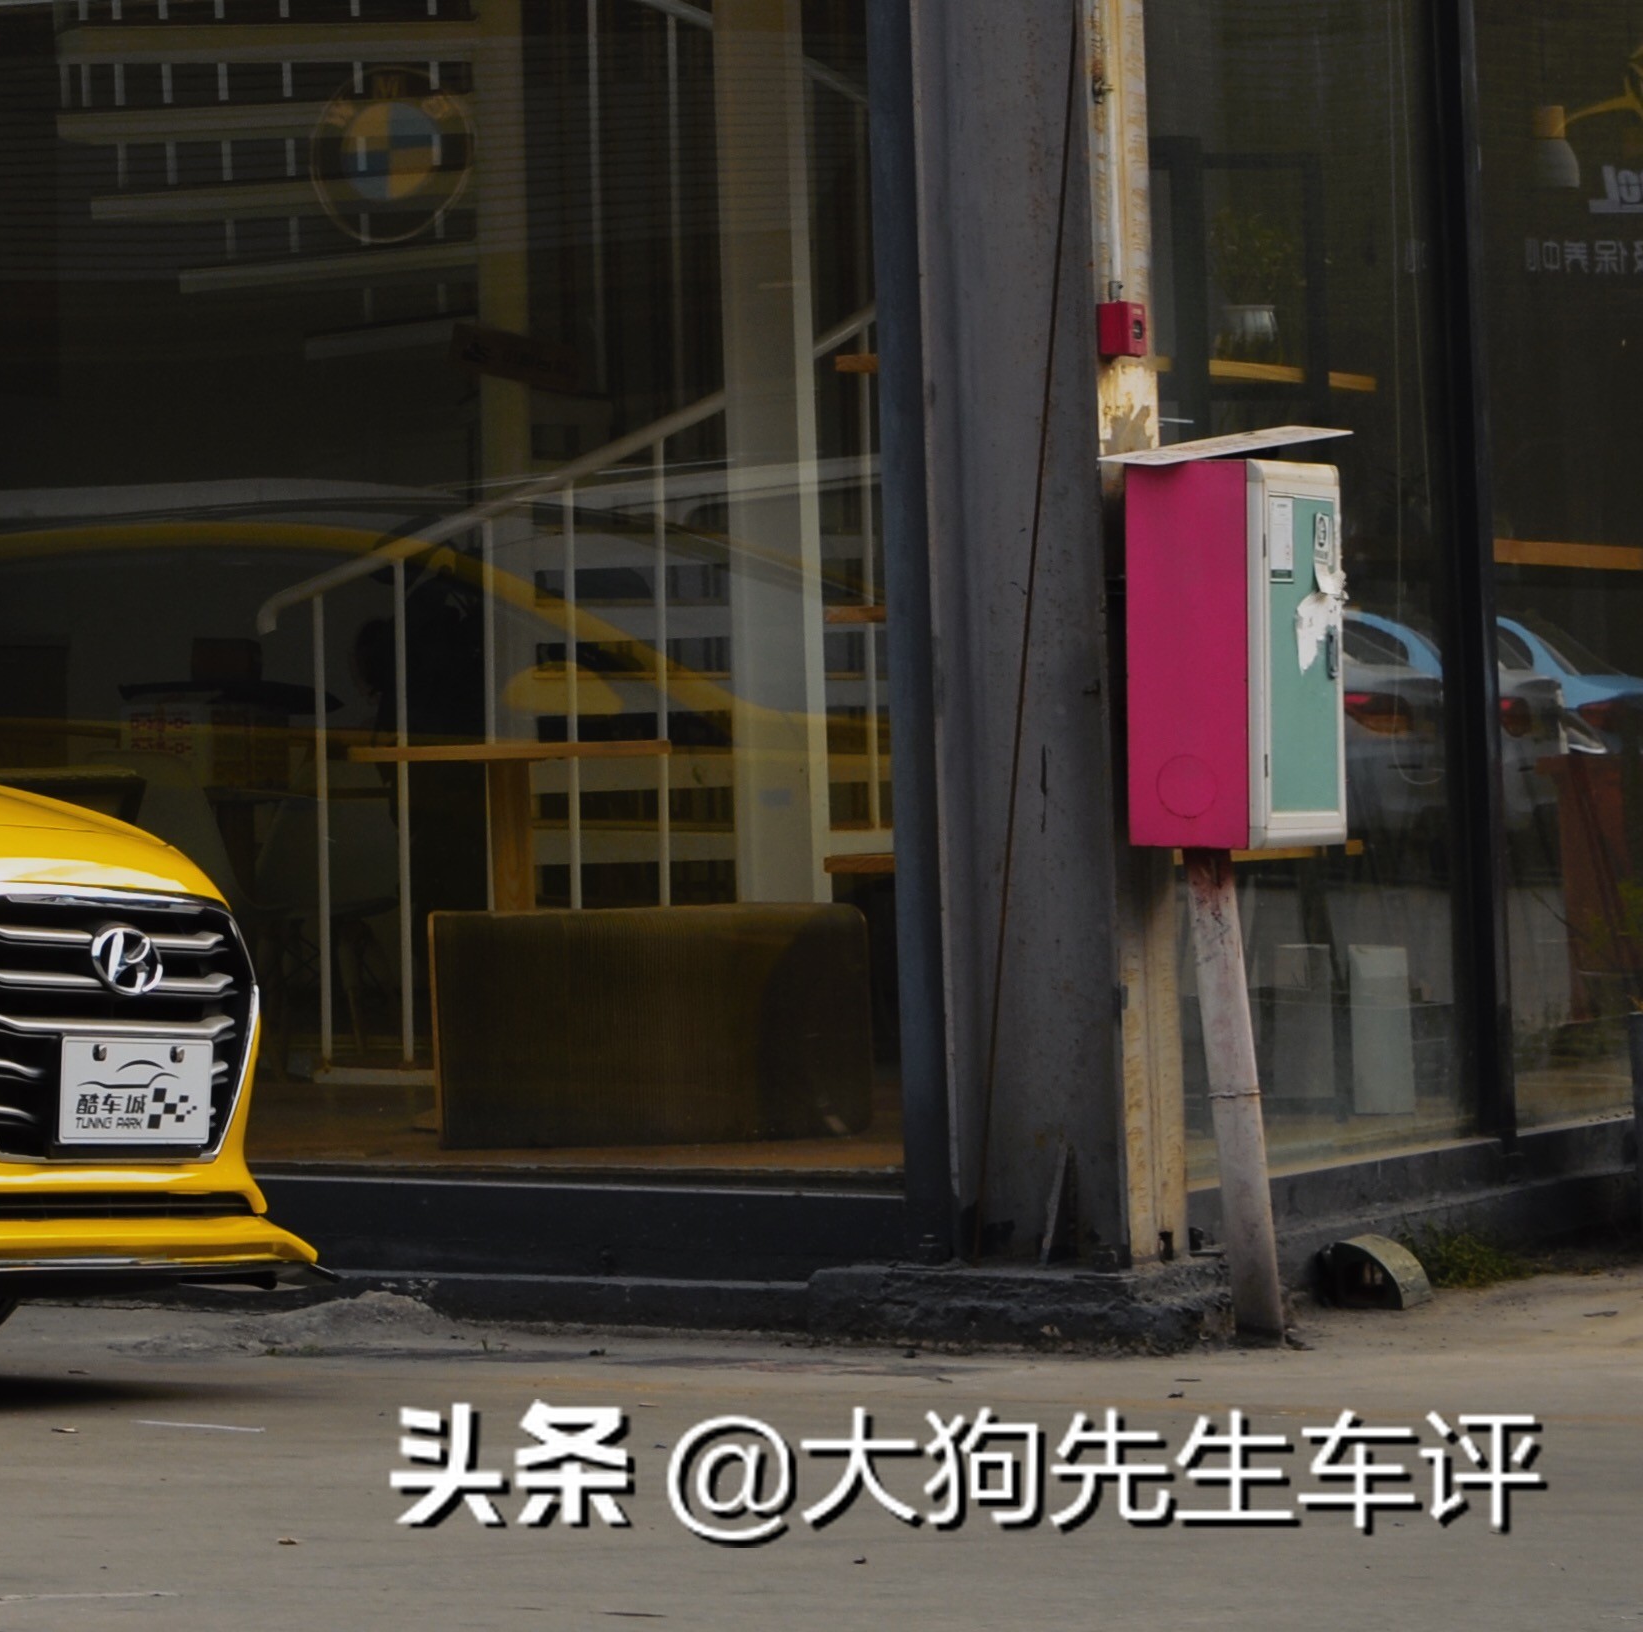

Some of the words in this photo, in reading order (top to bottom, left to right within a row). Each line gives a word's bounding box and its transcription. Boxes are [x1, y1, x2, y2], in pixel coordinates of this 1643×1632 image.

[75, 1092, 148, 1115] 酷车城
[75, 1116, 113, 1129] TUNING
[116, 1116, 144, 1130] PARK
